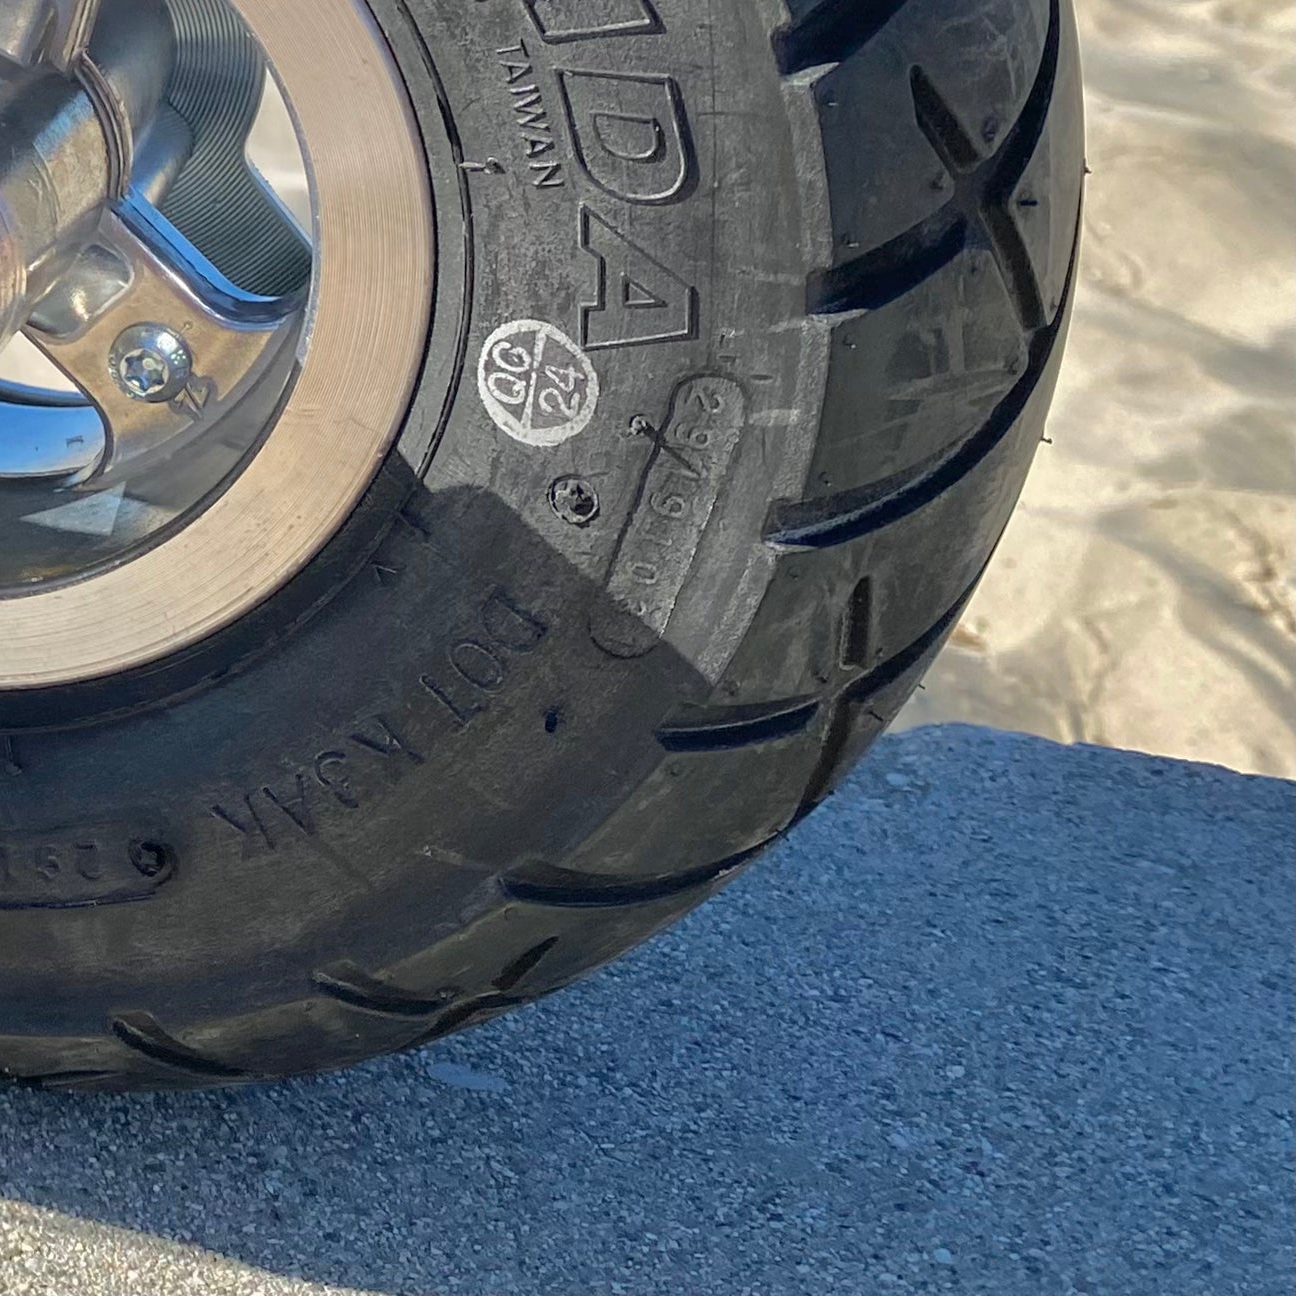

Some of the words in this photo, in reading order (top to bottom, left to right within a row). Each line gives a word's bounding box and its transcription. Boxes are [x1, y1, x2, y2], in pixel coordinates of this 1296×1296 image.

[494, 37, 565, 189] TAIWAN
[538, 365, 585, 419] 24
[418, 583, 550, 732] DOT
